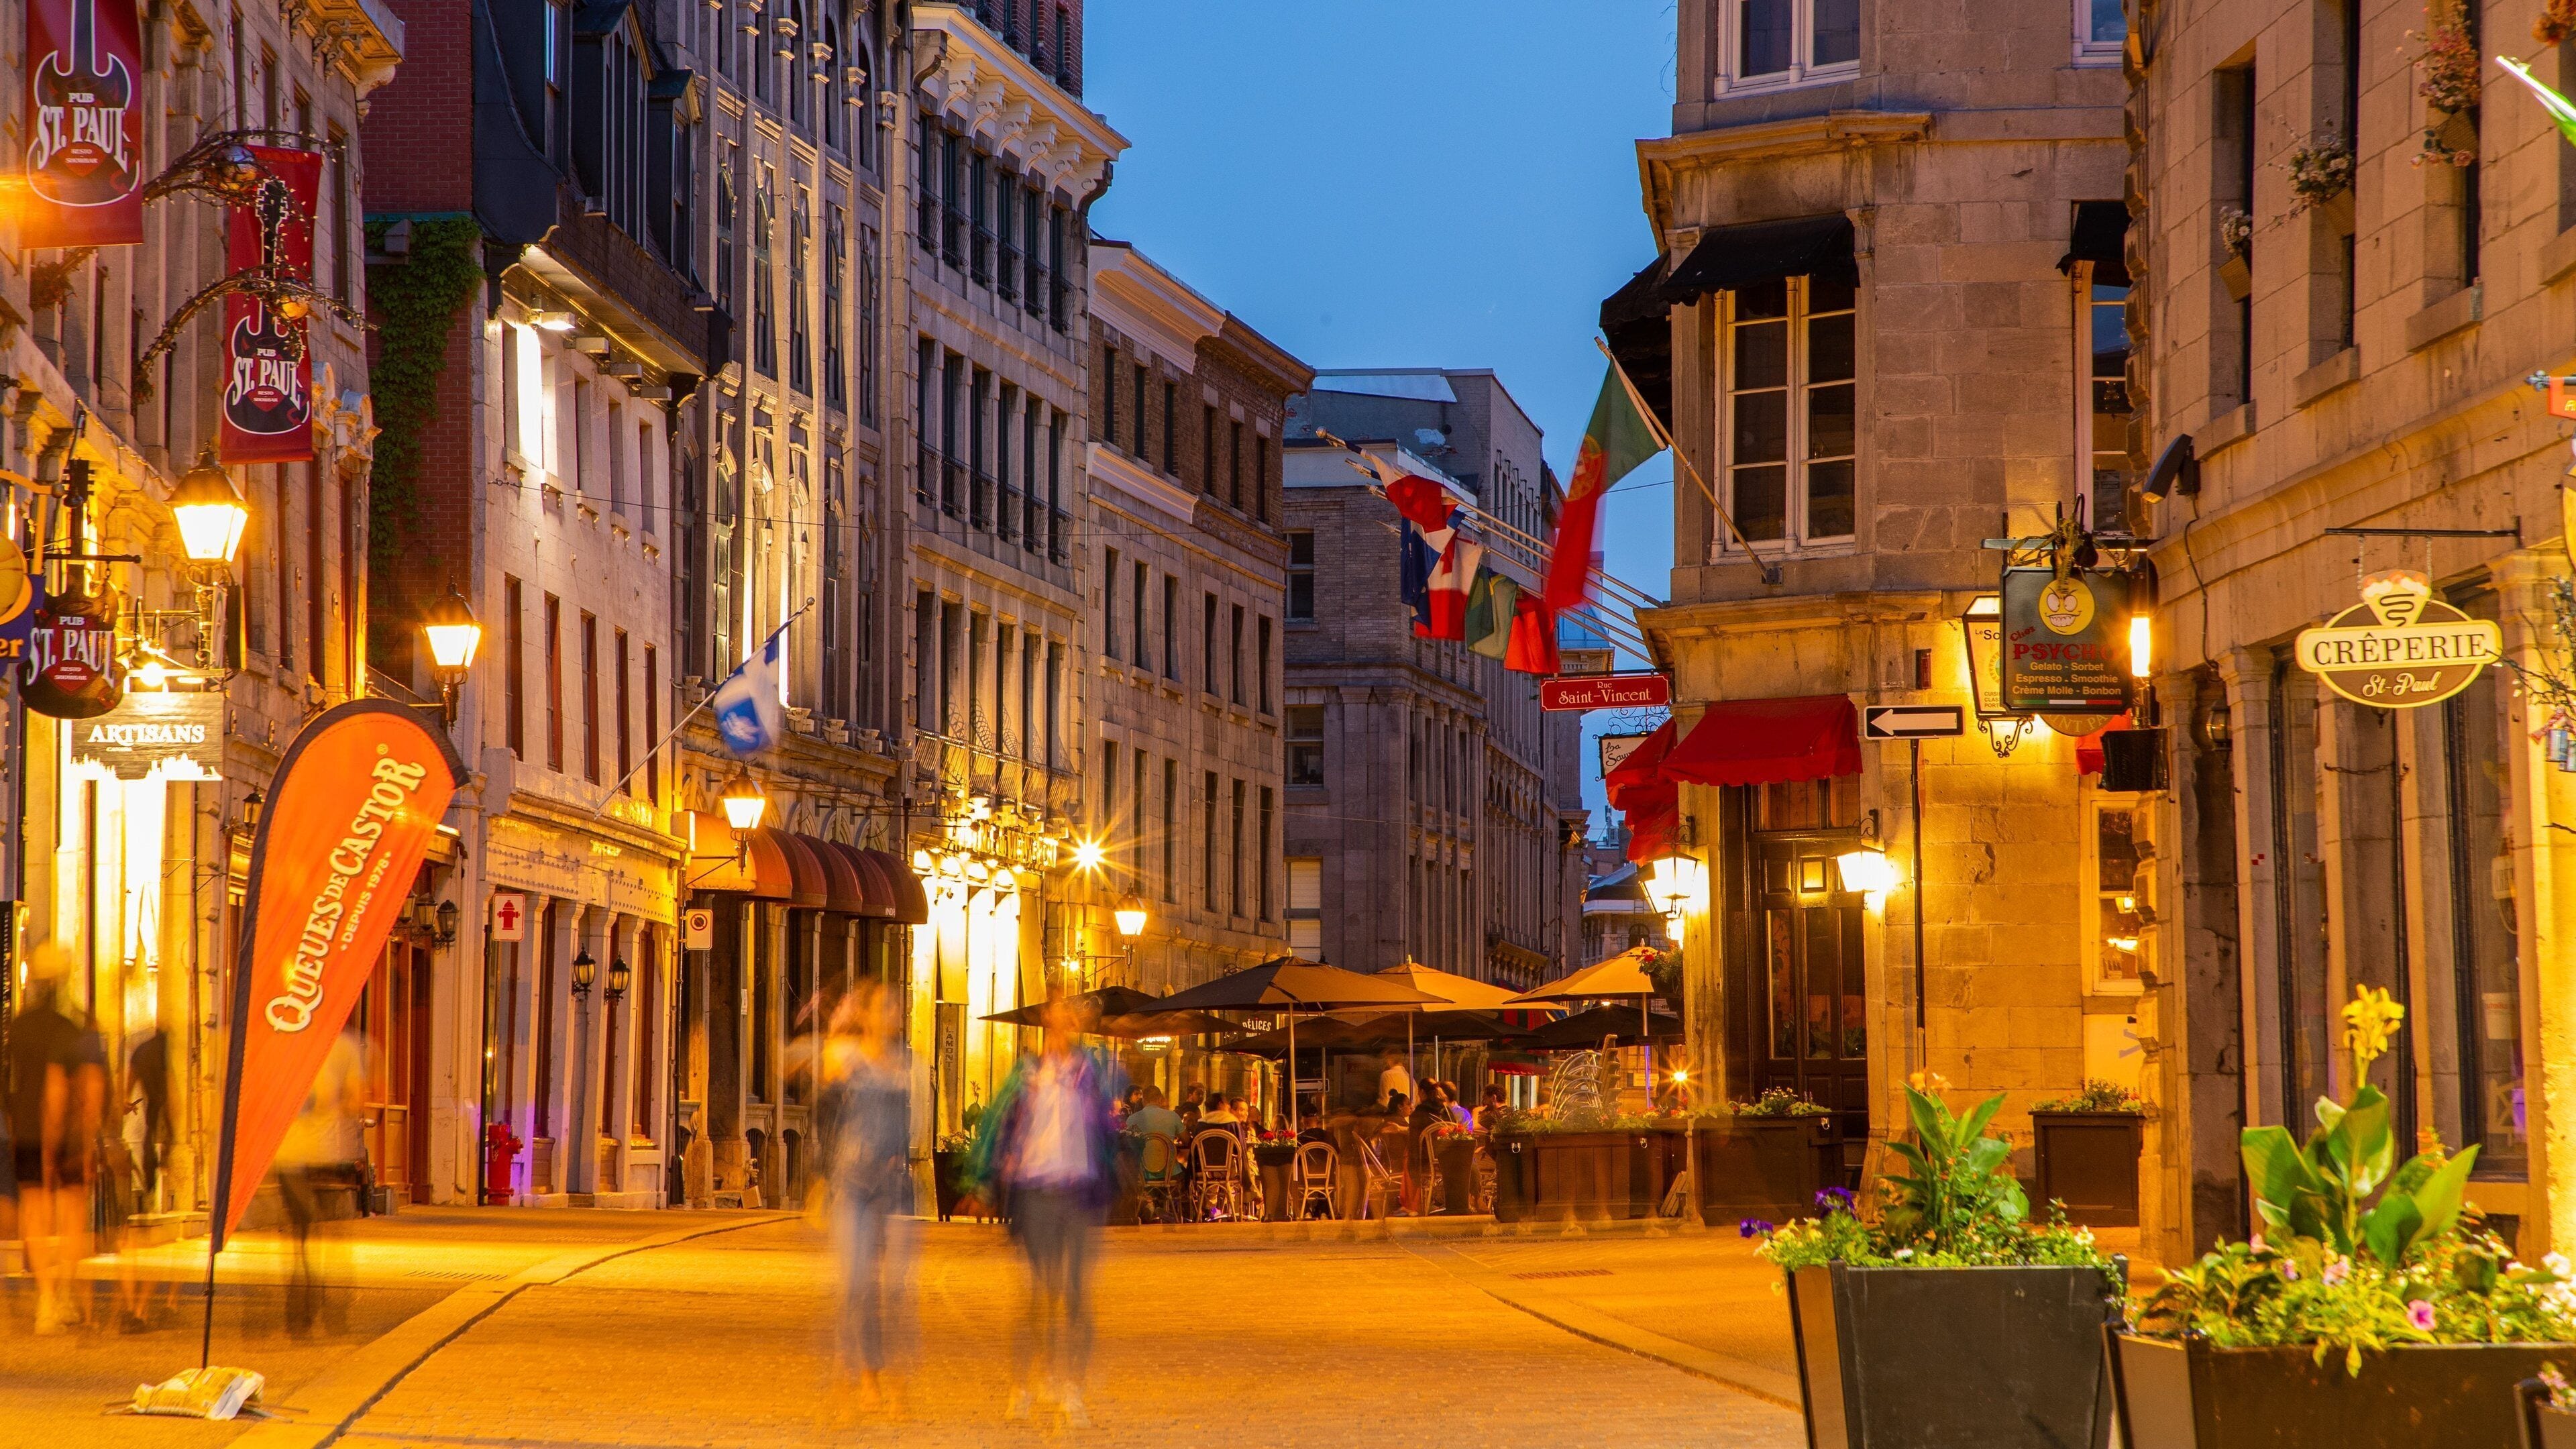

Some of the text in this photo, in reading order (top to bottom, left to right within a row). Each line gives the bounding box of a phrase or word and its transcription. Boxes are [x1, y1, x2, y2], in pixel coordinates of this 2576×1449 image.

[68, 93, 95, 103] PUB
[37, 105, 127, 173] ST. PAUL
[257, 348, 276, 357] PUB
[232, 356, 301, 411] ST. PAUL
[58, 616, 85, 625] PUB
[2012, 643, 2118, 660] PSYCHO
[2314, 632, 2487, 665] CRÊPERIE
[26, 627, 115, 689] ST. PAUL
[2030, 661, 2063, 671] Gelato
[2071, 661, 2104, 671] Sorbet
[1597, 681, 1613, 689] Rue
[2016, 674, 2062, 684] Espresso
[2071, 674, 2118, 683] Smoothie
[2362, 671, 2443, 697] St-Paul
[1558, 688, 1652, 704] Saint-Vincent
[2012, 686, 2045, 695] Crème
[2047, 686, 2074, 695] Molle
[2083, 686, 2122, 695] Bonbon
[87, 724, 205, 746] ARTISANS
[341, 858, 390, 943] DEPUIS 1978
